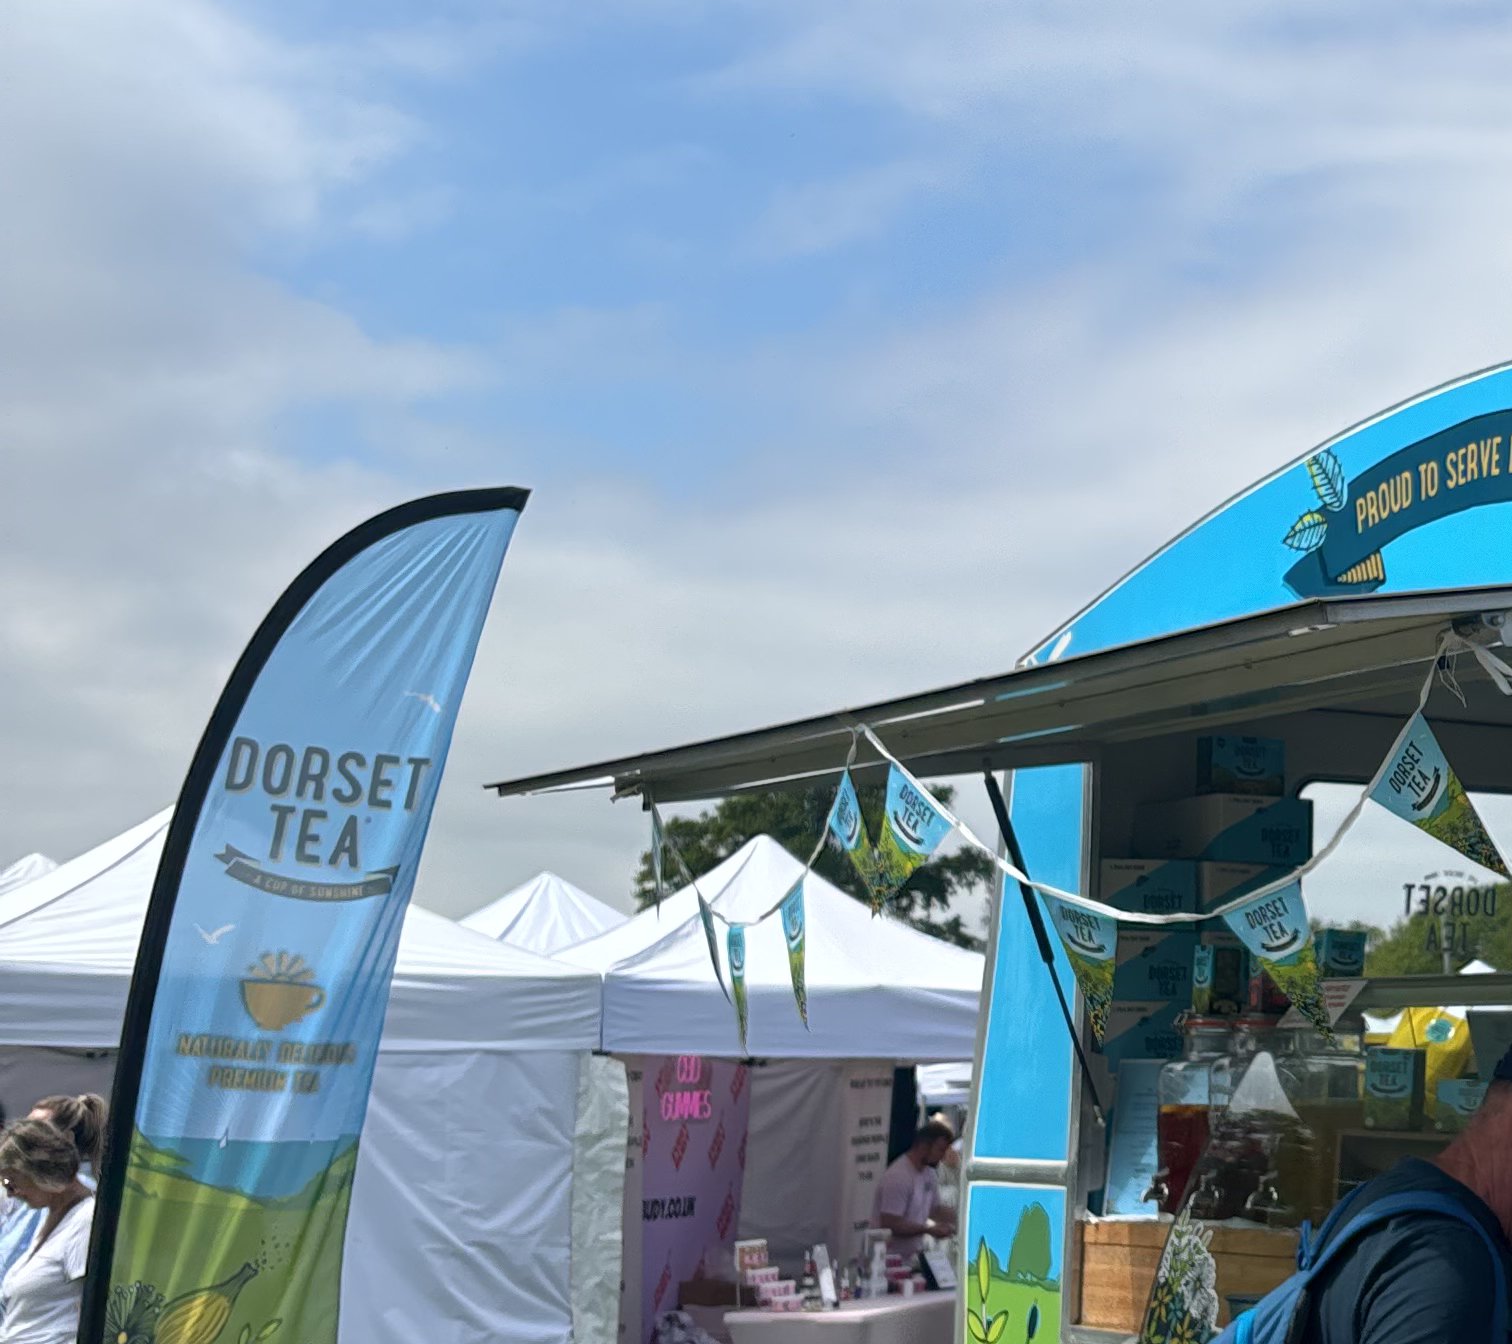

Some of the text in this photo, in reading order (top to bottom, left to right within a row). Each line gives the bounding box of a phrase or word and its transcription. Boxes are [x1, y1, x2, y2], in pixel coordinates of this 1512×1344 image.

[1356, 471, 1413, 534] PROUD
[1418, 460, 1439, 501] TO
[1446, 435, 1503, 489] SERVE
[224, 736, 432, 812] DORSET
[1389, 741, 1424, 794] DORSET
[1408, 769, 1431, 798] TEA
[900, 783, 936, 826] DORSET
[902, 805, 920, 833] TEA
[268, 804, 361, 869] TEA
[1244, 897, 1290, 929] DORSET
[1263, 921, 1289, 943] TEA
